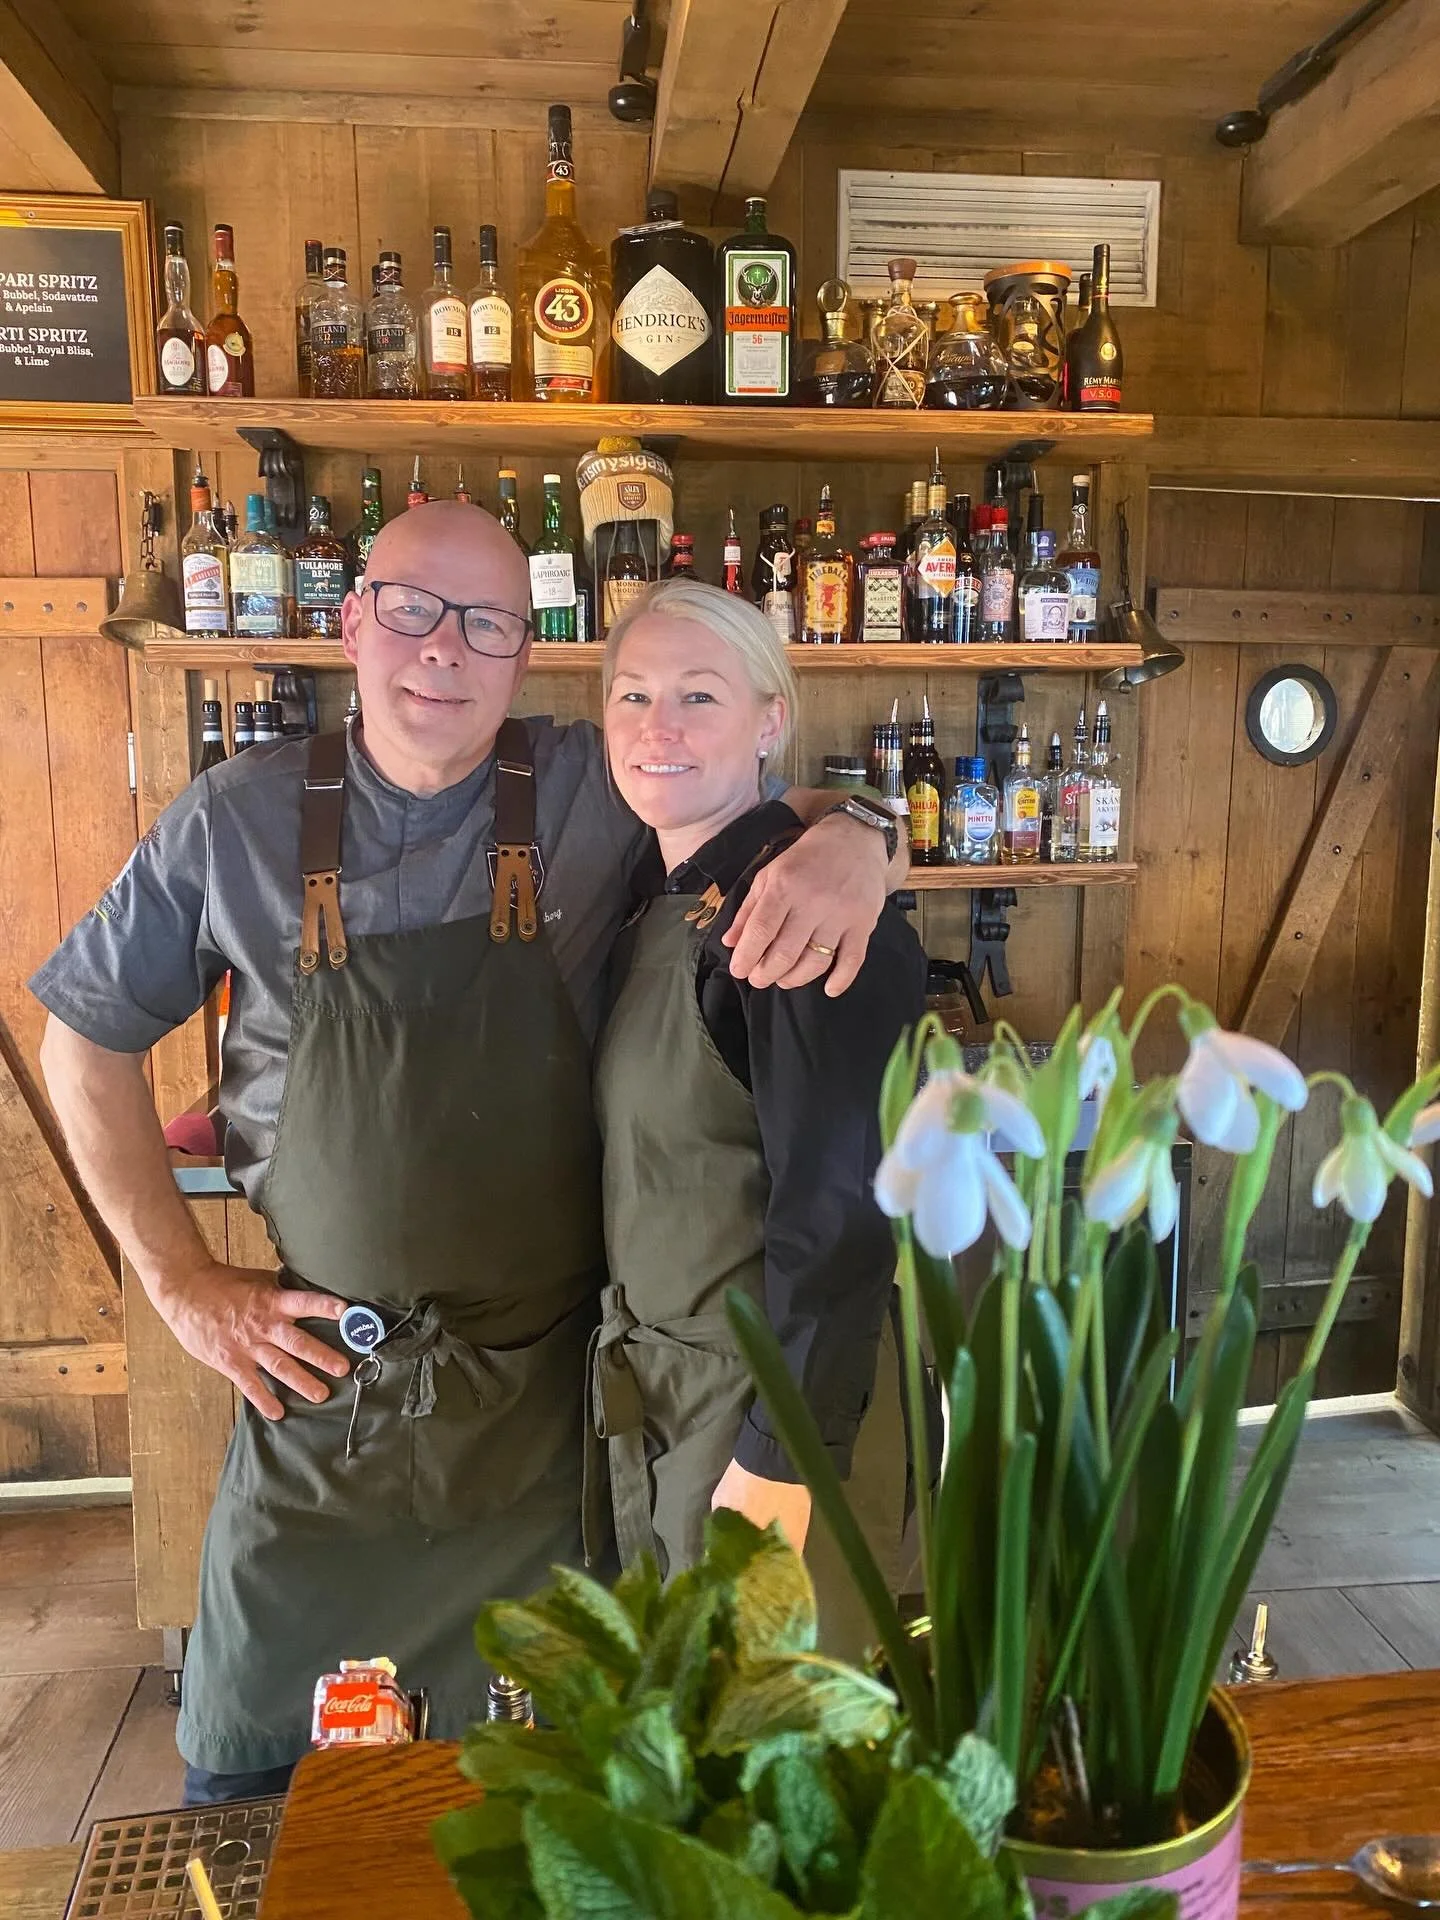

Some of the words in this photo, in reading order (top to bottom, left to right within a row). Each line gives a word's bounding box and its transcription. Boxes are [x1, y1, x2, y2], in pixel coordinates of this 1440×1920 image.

[555, 163, 569, 176] 43
[38, 274, 98, 289] SPRITZ
[3, 290, 41, 301] Bubbel,
[42, 291, 99, 302] Sodavatten
[5, 302, 14, 312] &
[15, 303, 53, 314] Apelsin
[545, 294, 580, 322] 43
[616, 313, 706, 333] HENDRICK'S
[28, 327, 88, 343] SPRITZ
[646, 335, 673, 343] GIN
[752, 334, 763, 345] 56
[37, 344, 65, 356] Royal
[66, 345, 94, 357] Bliss,
[14, 356, 22, 365] &
[24, 356, 50, 366] Lime
[299, 561, 344, 571] TULLAMORE
[968, 815, 993, 823] MINTTU
